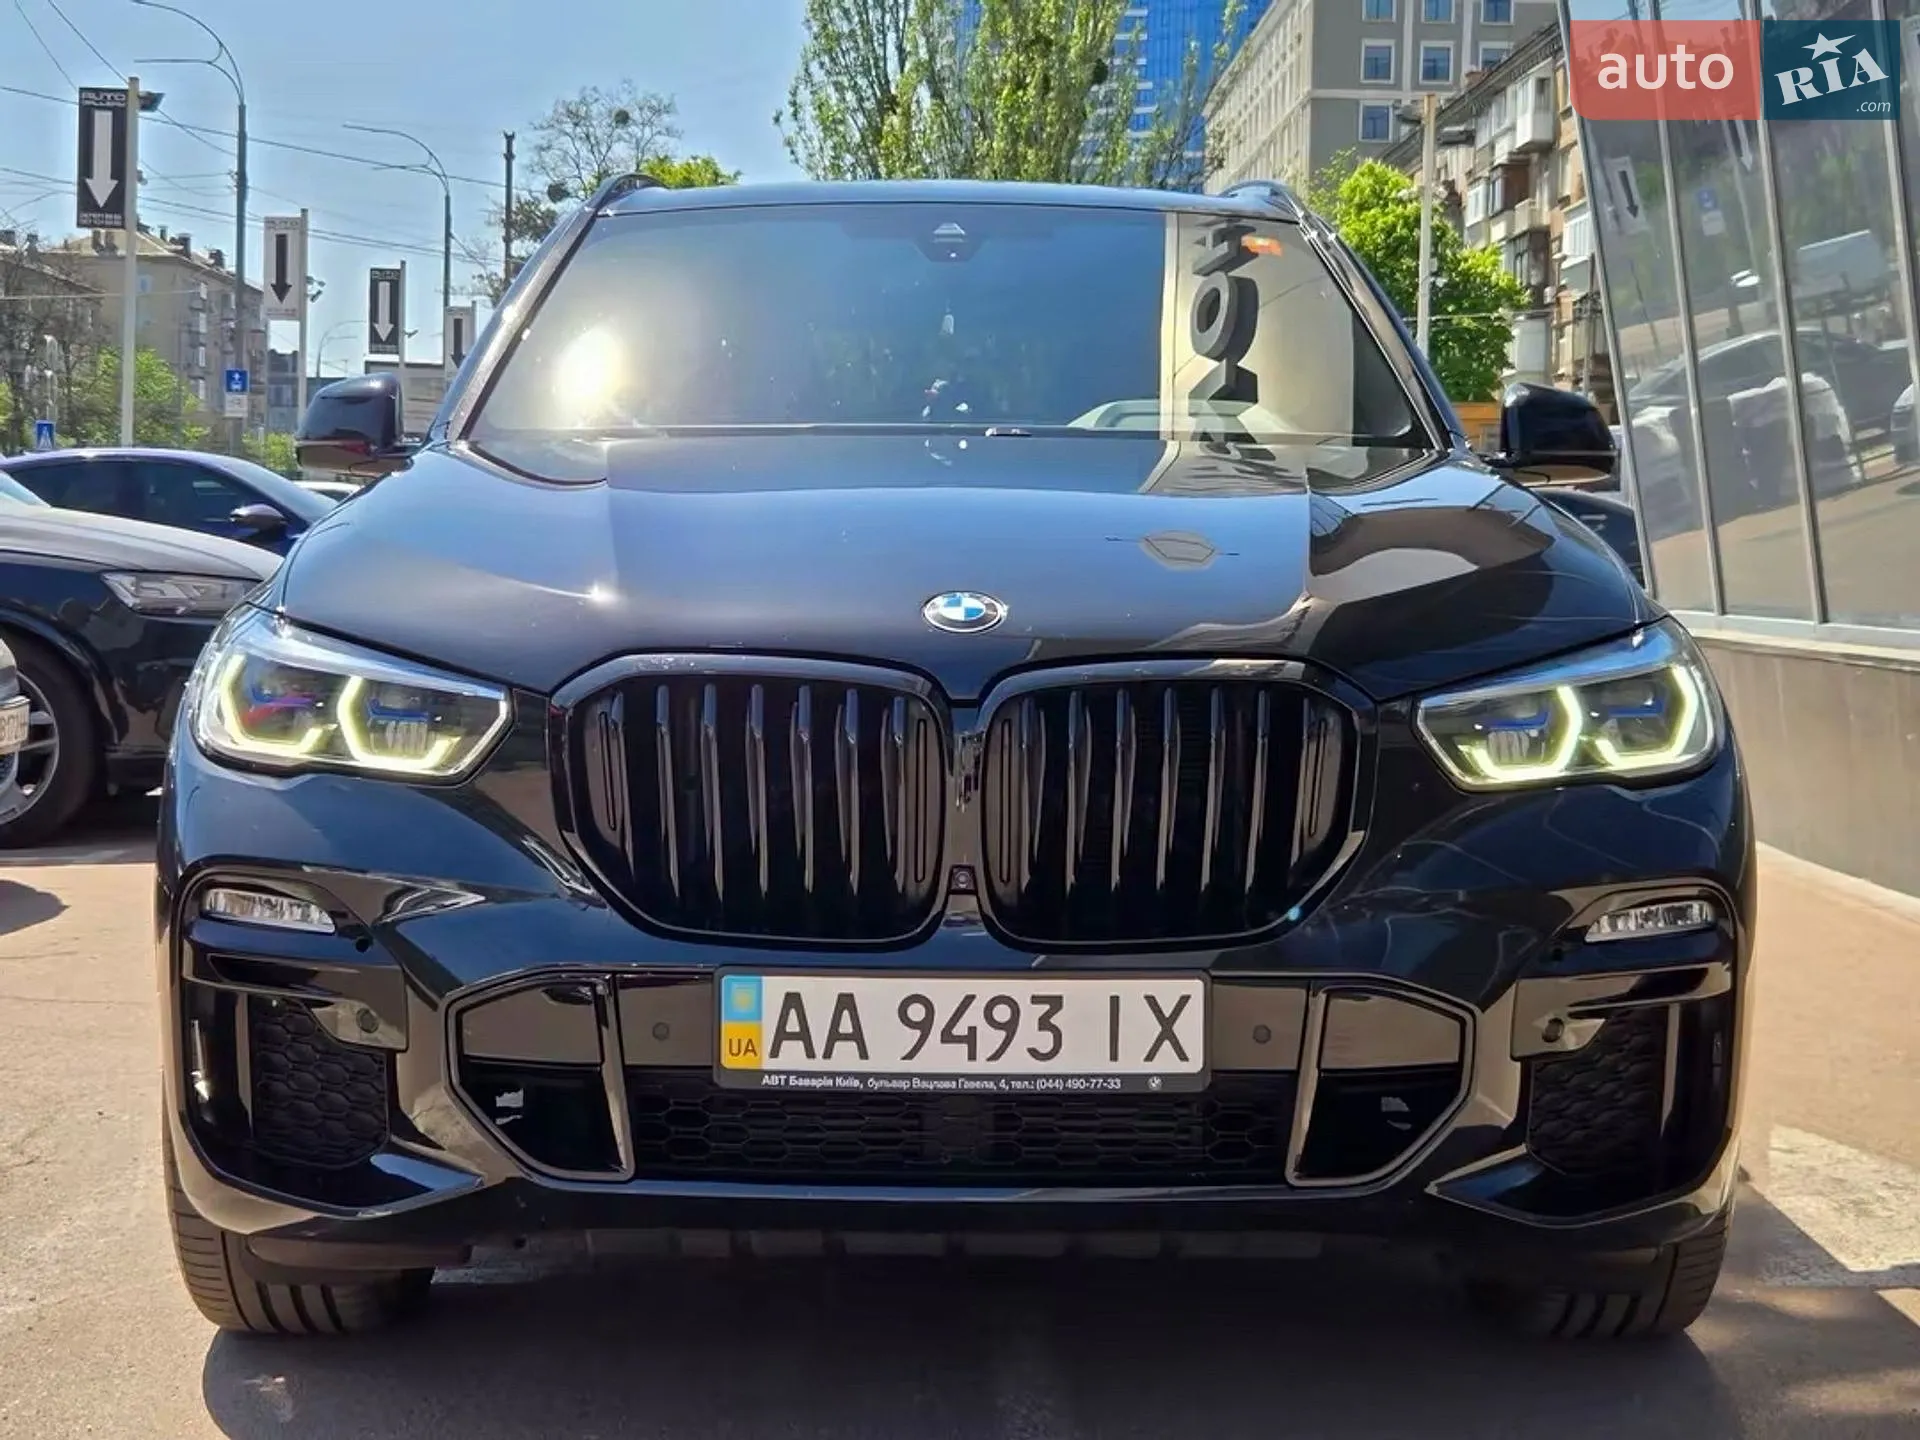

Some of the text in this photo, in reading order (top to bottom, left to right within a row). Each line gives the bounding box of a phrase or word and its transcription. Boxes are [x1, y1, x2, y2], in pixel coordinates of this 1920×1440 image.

[768, 991, 1192, 1062] AA 9493 IX
[728, 1038, 758, 1057] UA
[1036, 1078, 1064, 1091] (044)
[1065, 1078, 1121, 1090] 490-77-33
